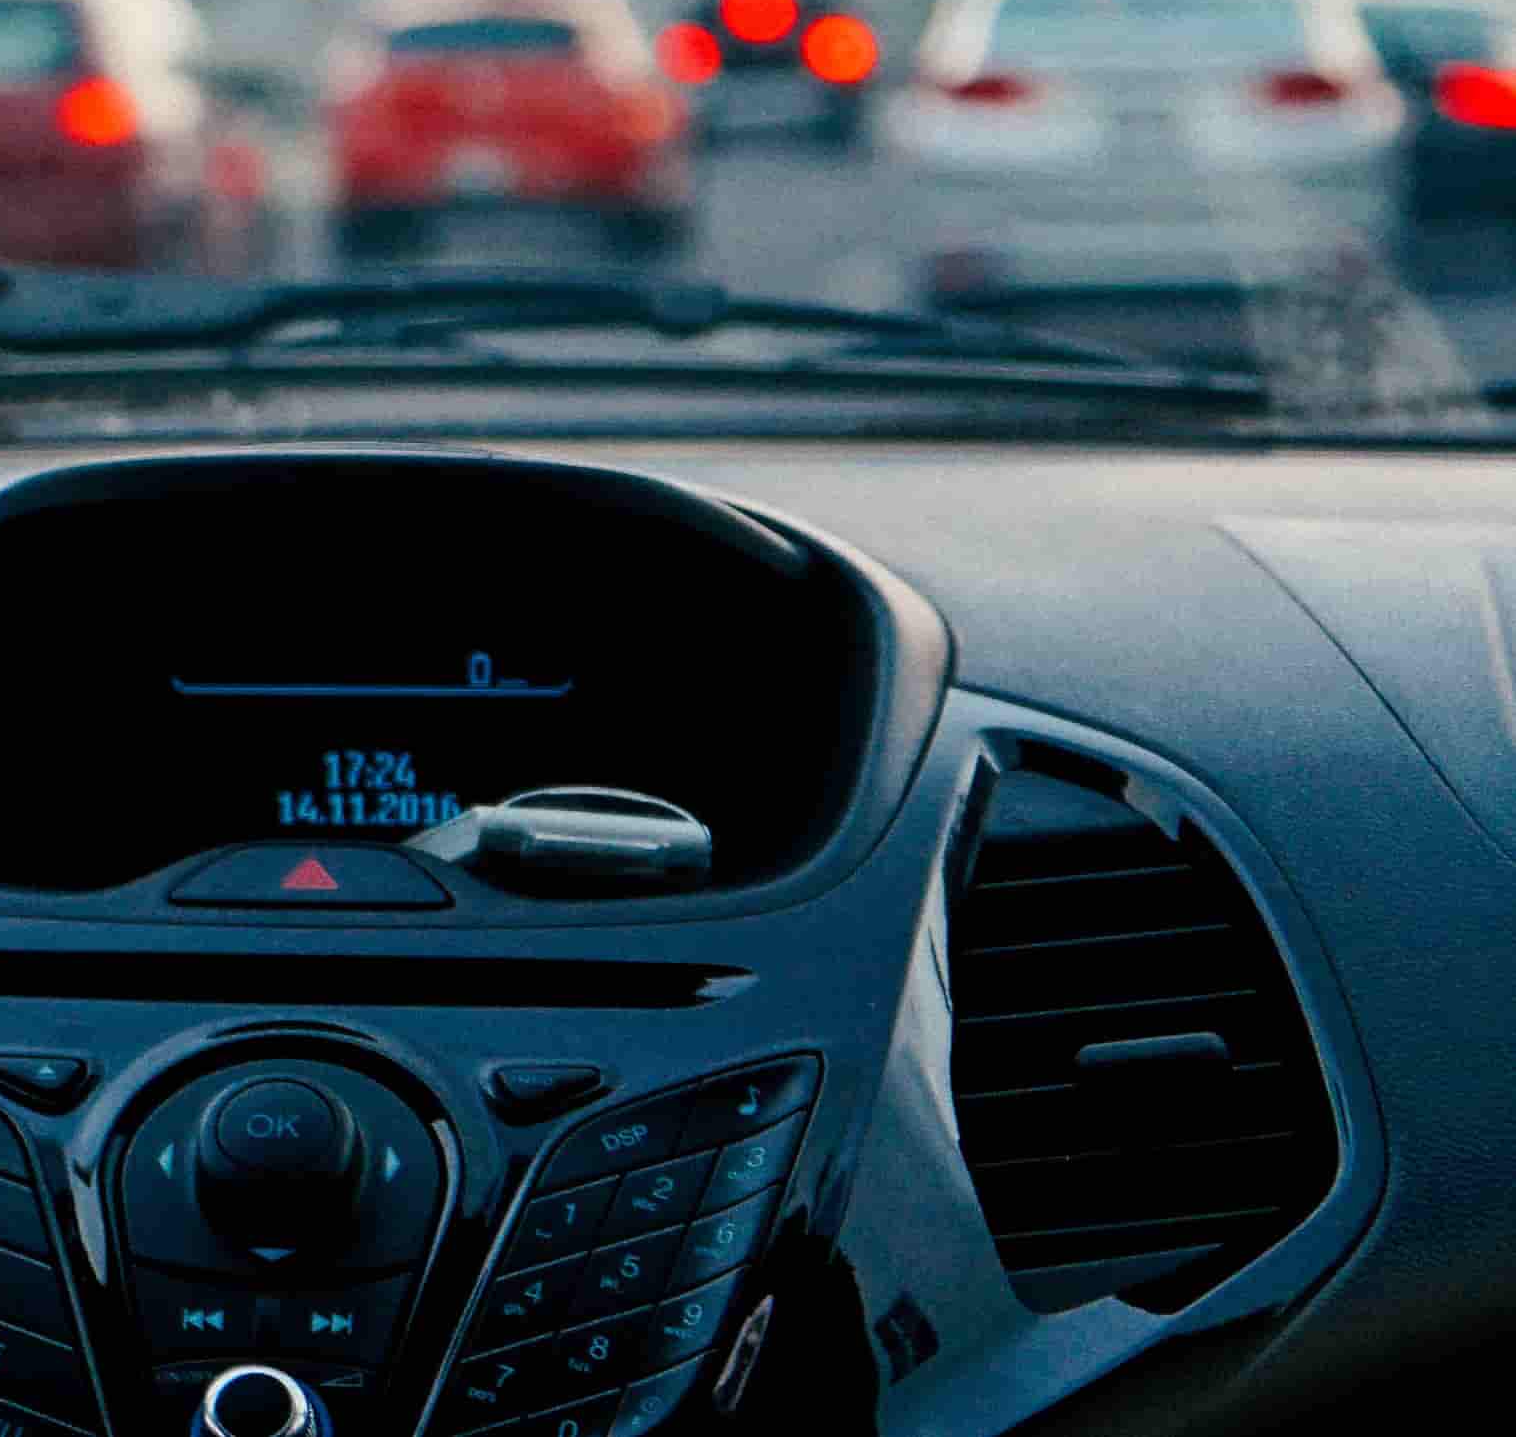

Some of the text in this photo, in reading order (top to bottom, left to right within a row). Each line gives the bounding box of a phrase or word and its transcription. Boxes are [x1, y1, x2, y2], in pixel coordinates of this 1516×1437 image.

[322, 750, 416, 789] 17:24
[277, 792, 460, 825] 14.11.2016
[245, 1112, 301, 1140] OK
[745, 1144, 767, 1169] 3
[652, 1176, 676, 1201] 2
[715, 1222, 736, 1246] 6
[618, 1253, 642, 1280] 5
[524, 1281, 545, 1305] 4
[681, 1303, 704, 1328] 9
[587, 1334, 612, 1361] 8
[497, 1363, 517, 1388] 7
